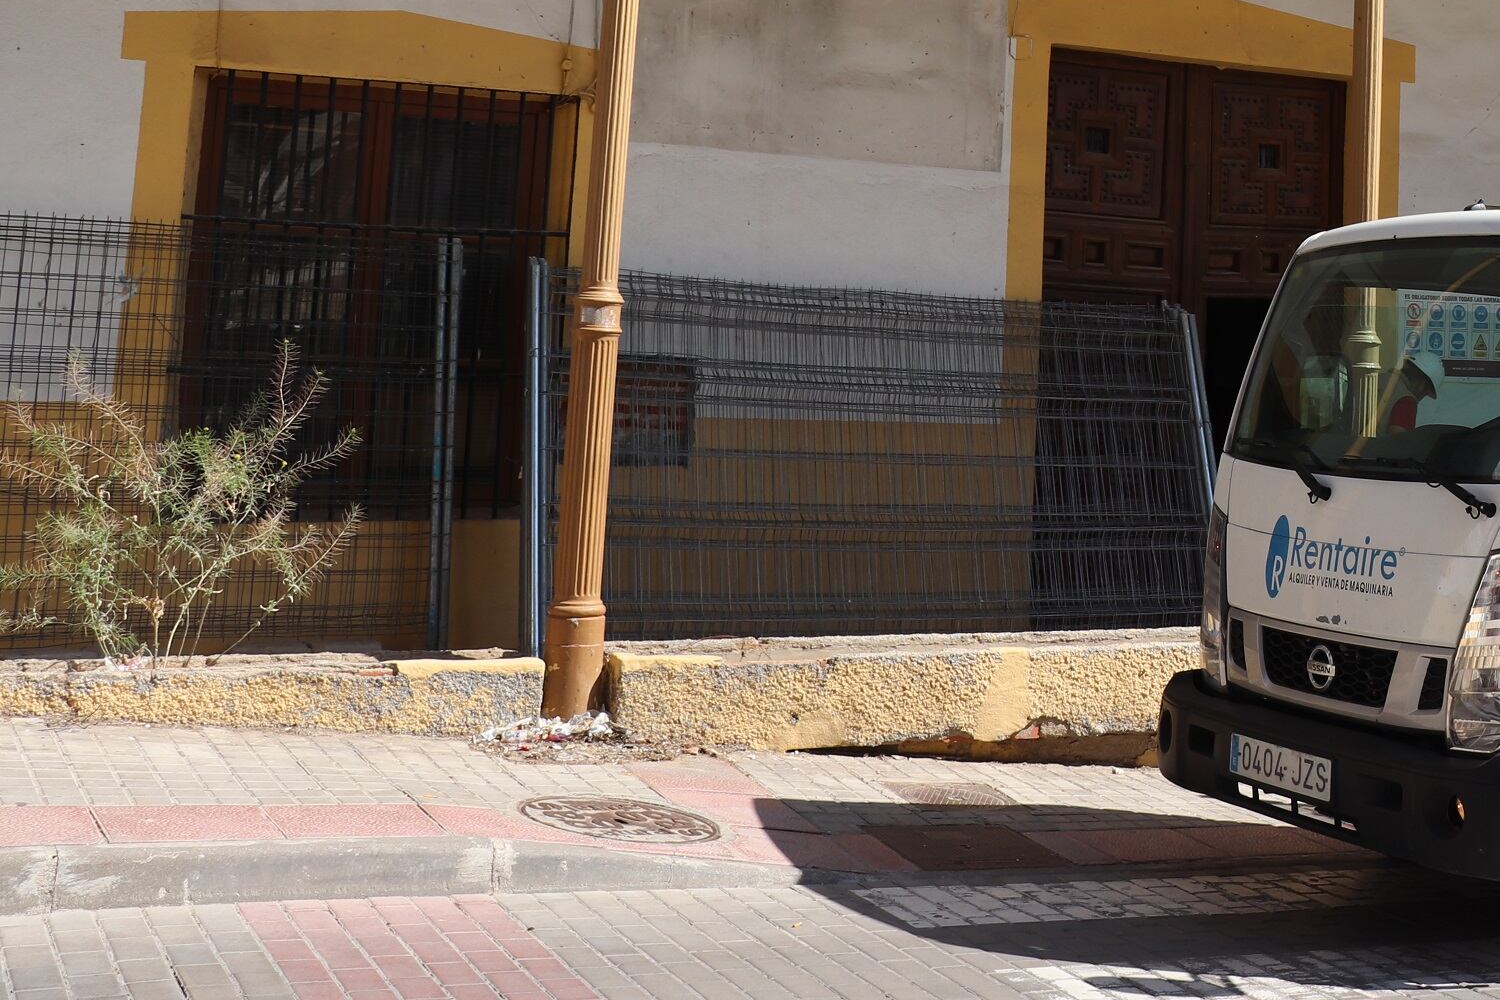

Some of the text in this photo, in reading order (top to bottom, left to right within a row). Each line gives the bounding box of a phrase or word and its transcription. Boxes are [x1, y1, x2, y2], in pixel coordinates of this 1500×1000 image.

[1272, 555, 1283, 590] R
[1291, 526, 1398, 580] Rentaire
[1289, 572, 1394, 597] ALQUILER Y VENTA DE MAQUINARIA
[1242, 742, 1326, 792] 0404 JZS
